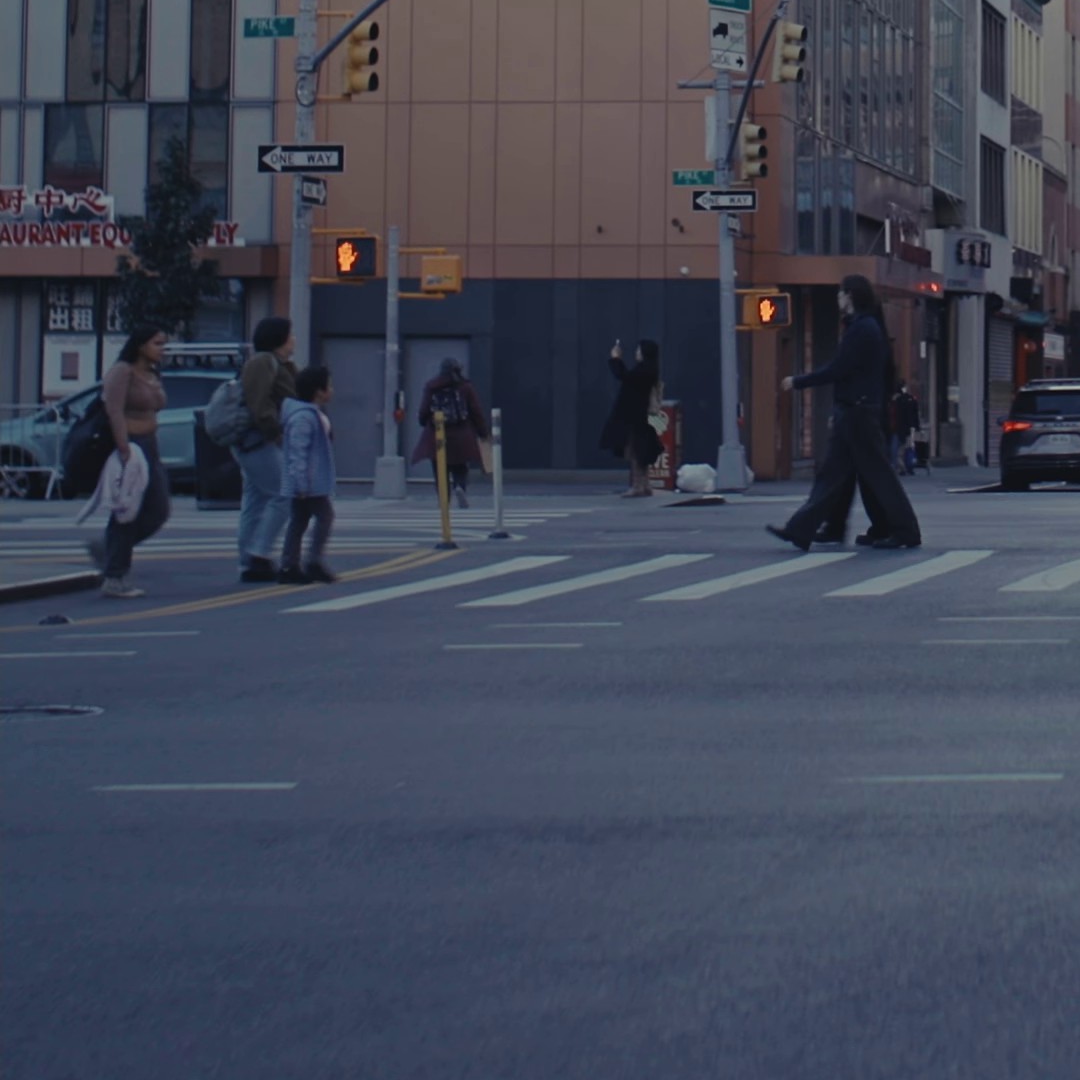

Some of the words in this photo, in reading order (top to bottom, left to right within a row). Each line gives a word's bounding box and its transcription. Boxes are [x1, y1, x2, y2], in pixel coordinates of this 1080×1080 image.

[270, 153, 294, 164] ONE
[306, 153, 333, 164] WAY
[701, 196, 721, 205] ONE
[729, 196, 749, 205] WAY
[48, 307, 93, 331] 出租
